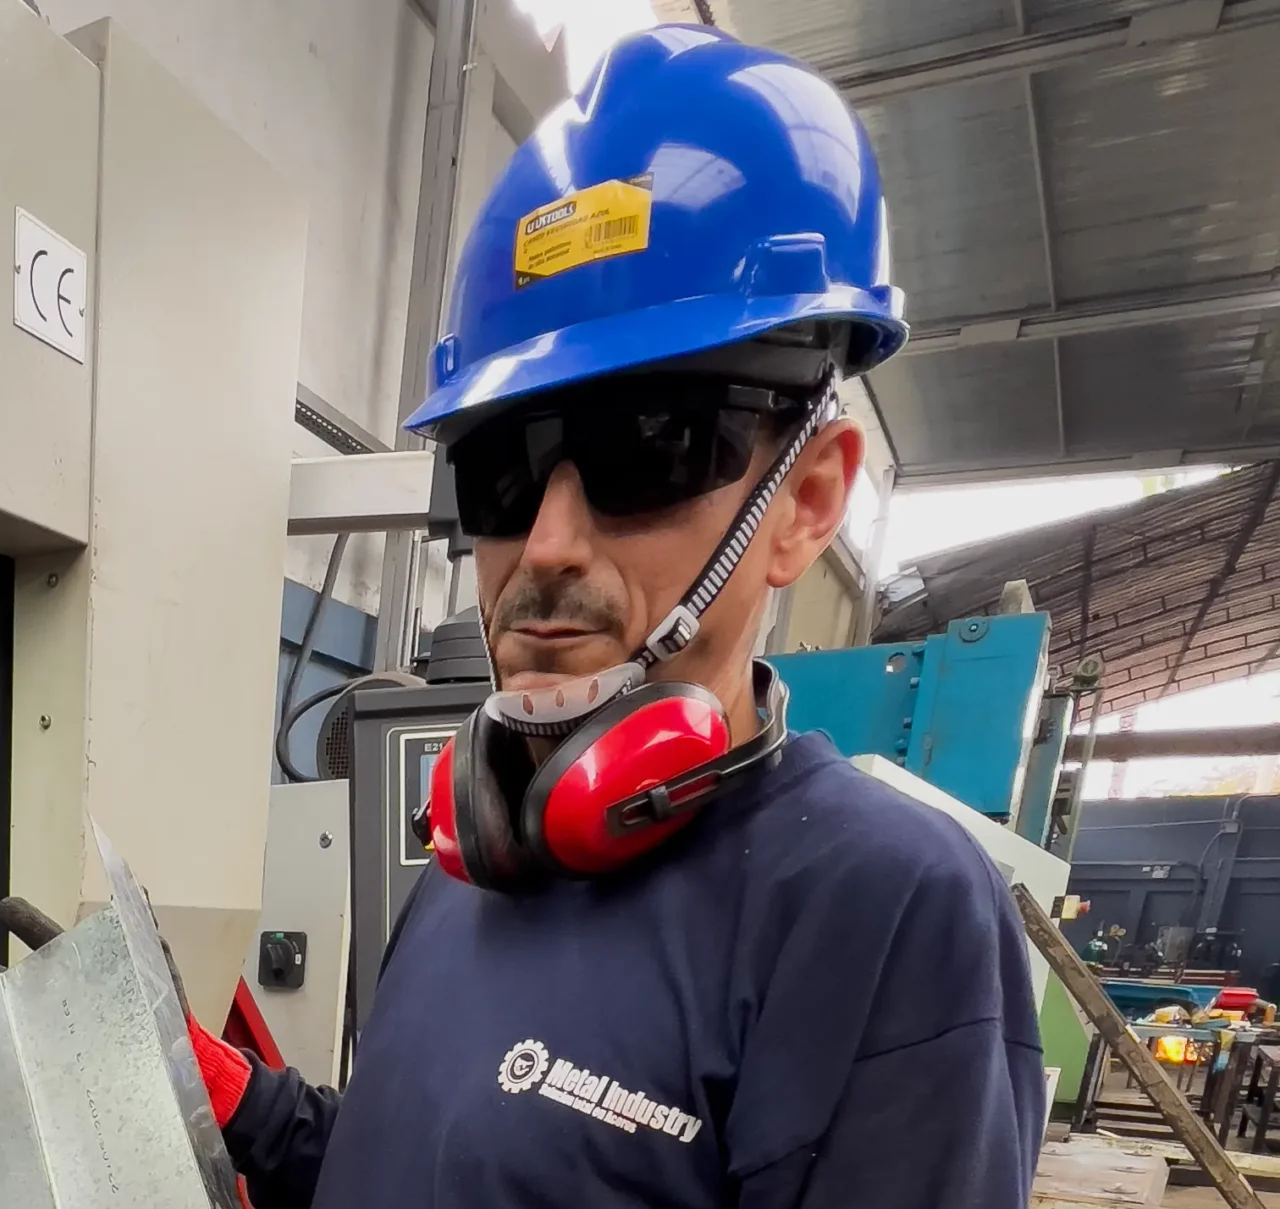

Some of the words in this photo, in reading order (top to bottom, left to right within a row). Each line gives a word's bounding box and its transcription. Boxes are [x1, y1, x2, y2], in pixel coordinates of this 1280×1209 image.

[30, 250, 74, 338] CE
[545, 1058, 610, 1105] Metal
[602, 1080, 703, 1143] Industry
